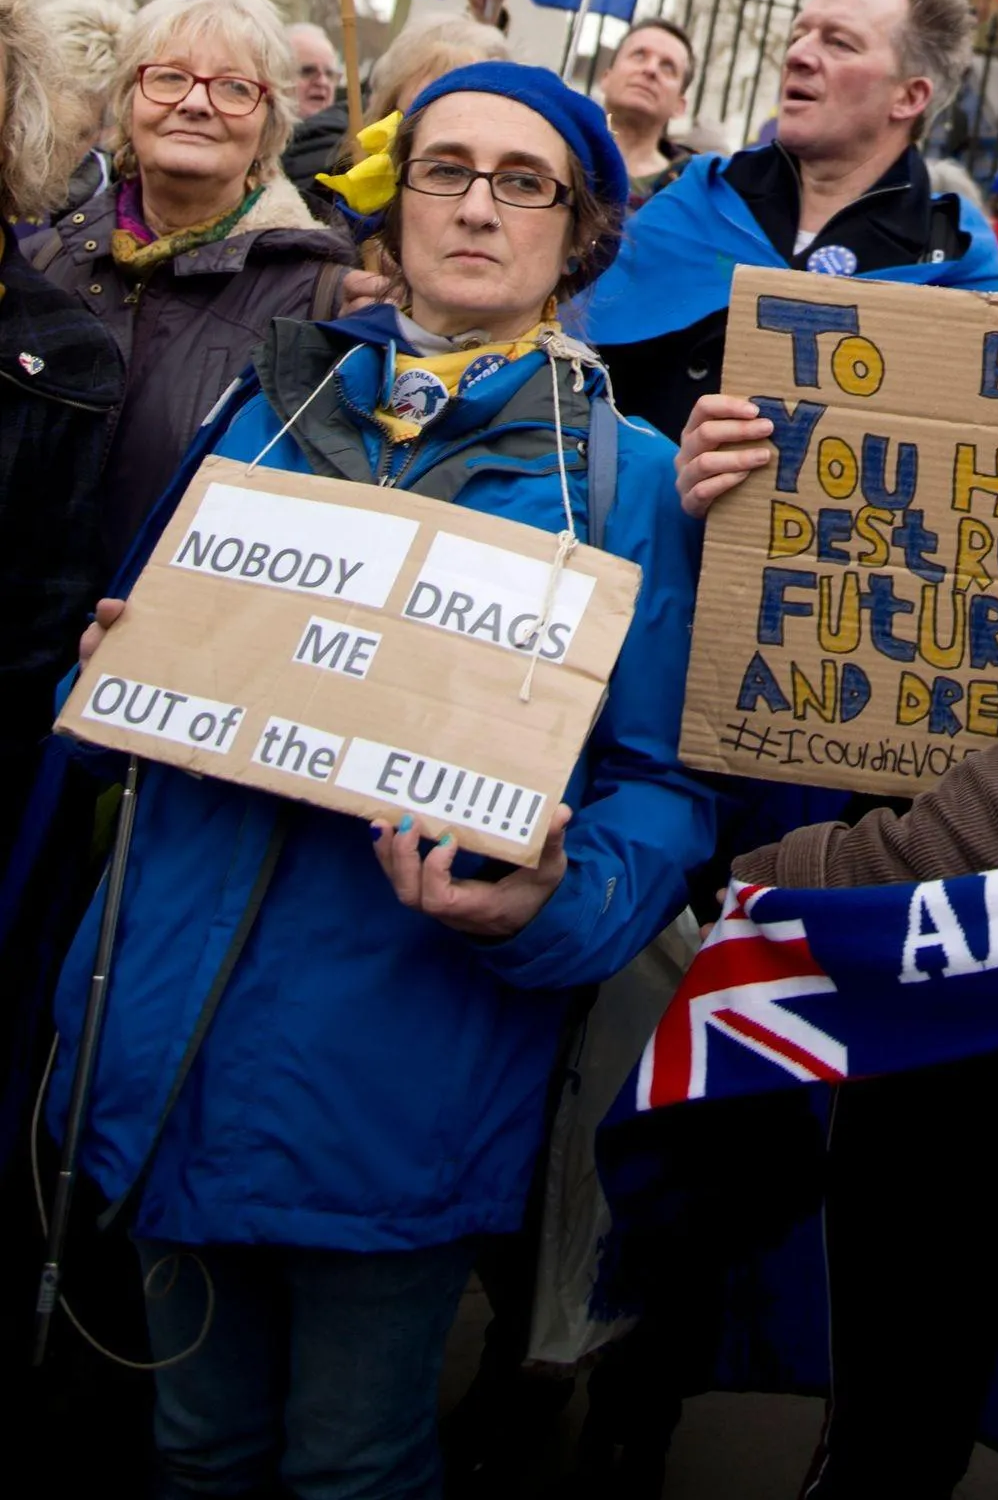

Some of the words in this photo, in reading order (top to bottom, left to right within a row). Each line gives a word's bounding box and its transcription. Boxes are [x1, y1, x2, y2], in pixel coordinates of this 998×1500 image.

[749, 396, 918, 511] YOU
[176, 529, 366, 595] NOBODY
[405, 580, 571, 660] DRAGS
[296, 624, 380, 678] ME
[736, 650, 872, 724] AND
[91, 677, 188, 731] OUT
[189, 705, 242, 747] of
[259, 724, 336, 780] the
[376, 751, 543, 837] EU!!!!!
